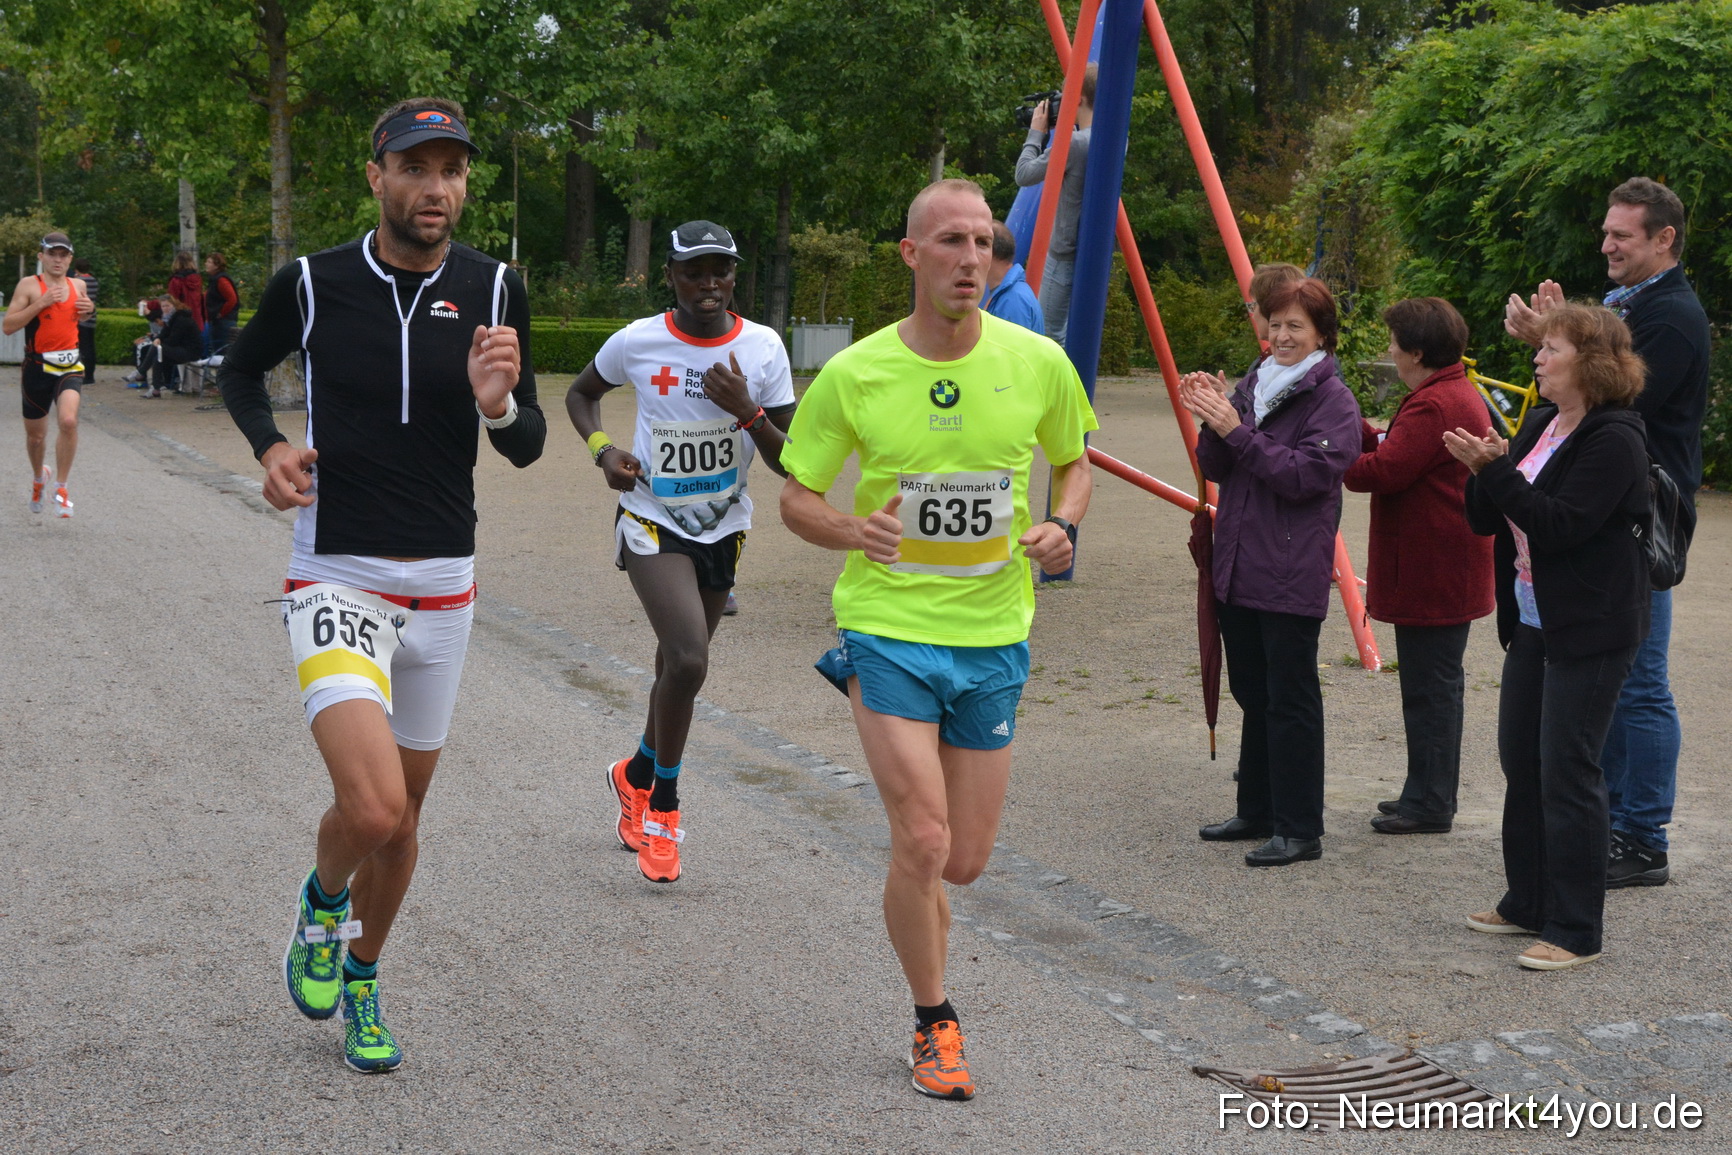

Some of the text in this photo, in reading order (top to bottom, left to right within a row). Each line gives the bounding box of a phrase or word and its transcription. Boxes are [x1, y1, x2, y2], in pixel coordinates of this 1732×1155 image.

[430, 309, 459, 320] skinfit
[685, 378, 705, 389] Rot
[932, 380, 958, 391] BMW
[684, 388, 711, 400] Kreu
[929, 414, 963, 426] Partl
[652, 427, 727, 438] PARTL Neumarkt
[659, 437, 734, 474] 2003
[674, 479, 721, 494] Zachary
[900, 480, 997, 493] PARTL Neumarkt
[918, 497, 993, 537] 635
[290, 592, 388, 621] PARTL Neumarkt
[312, 605, 380, 659] 655
